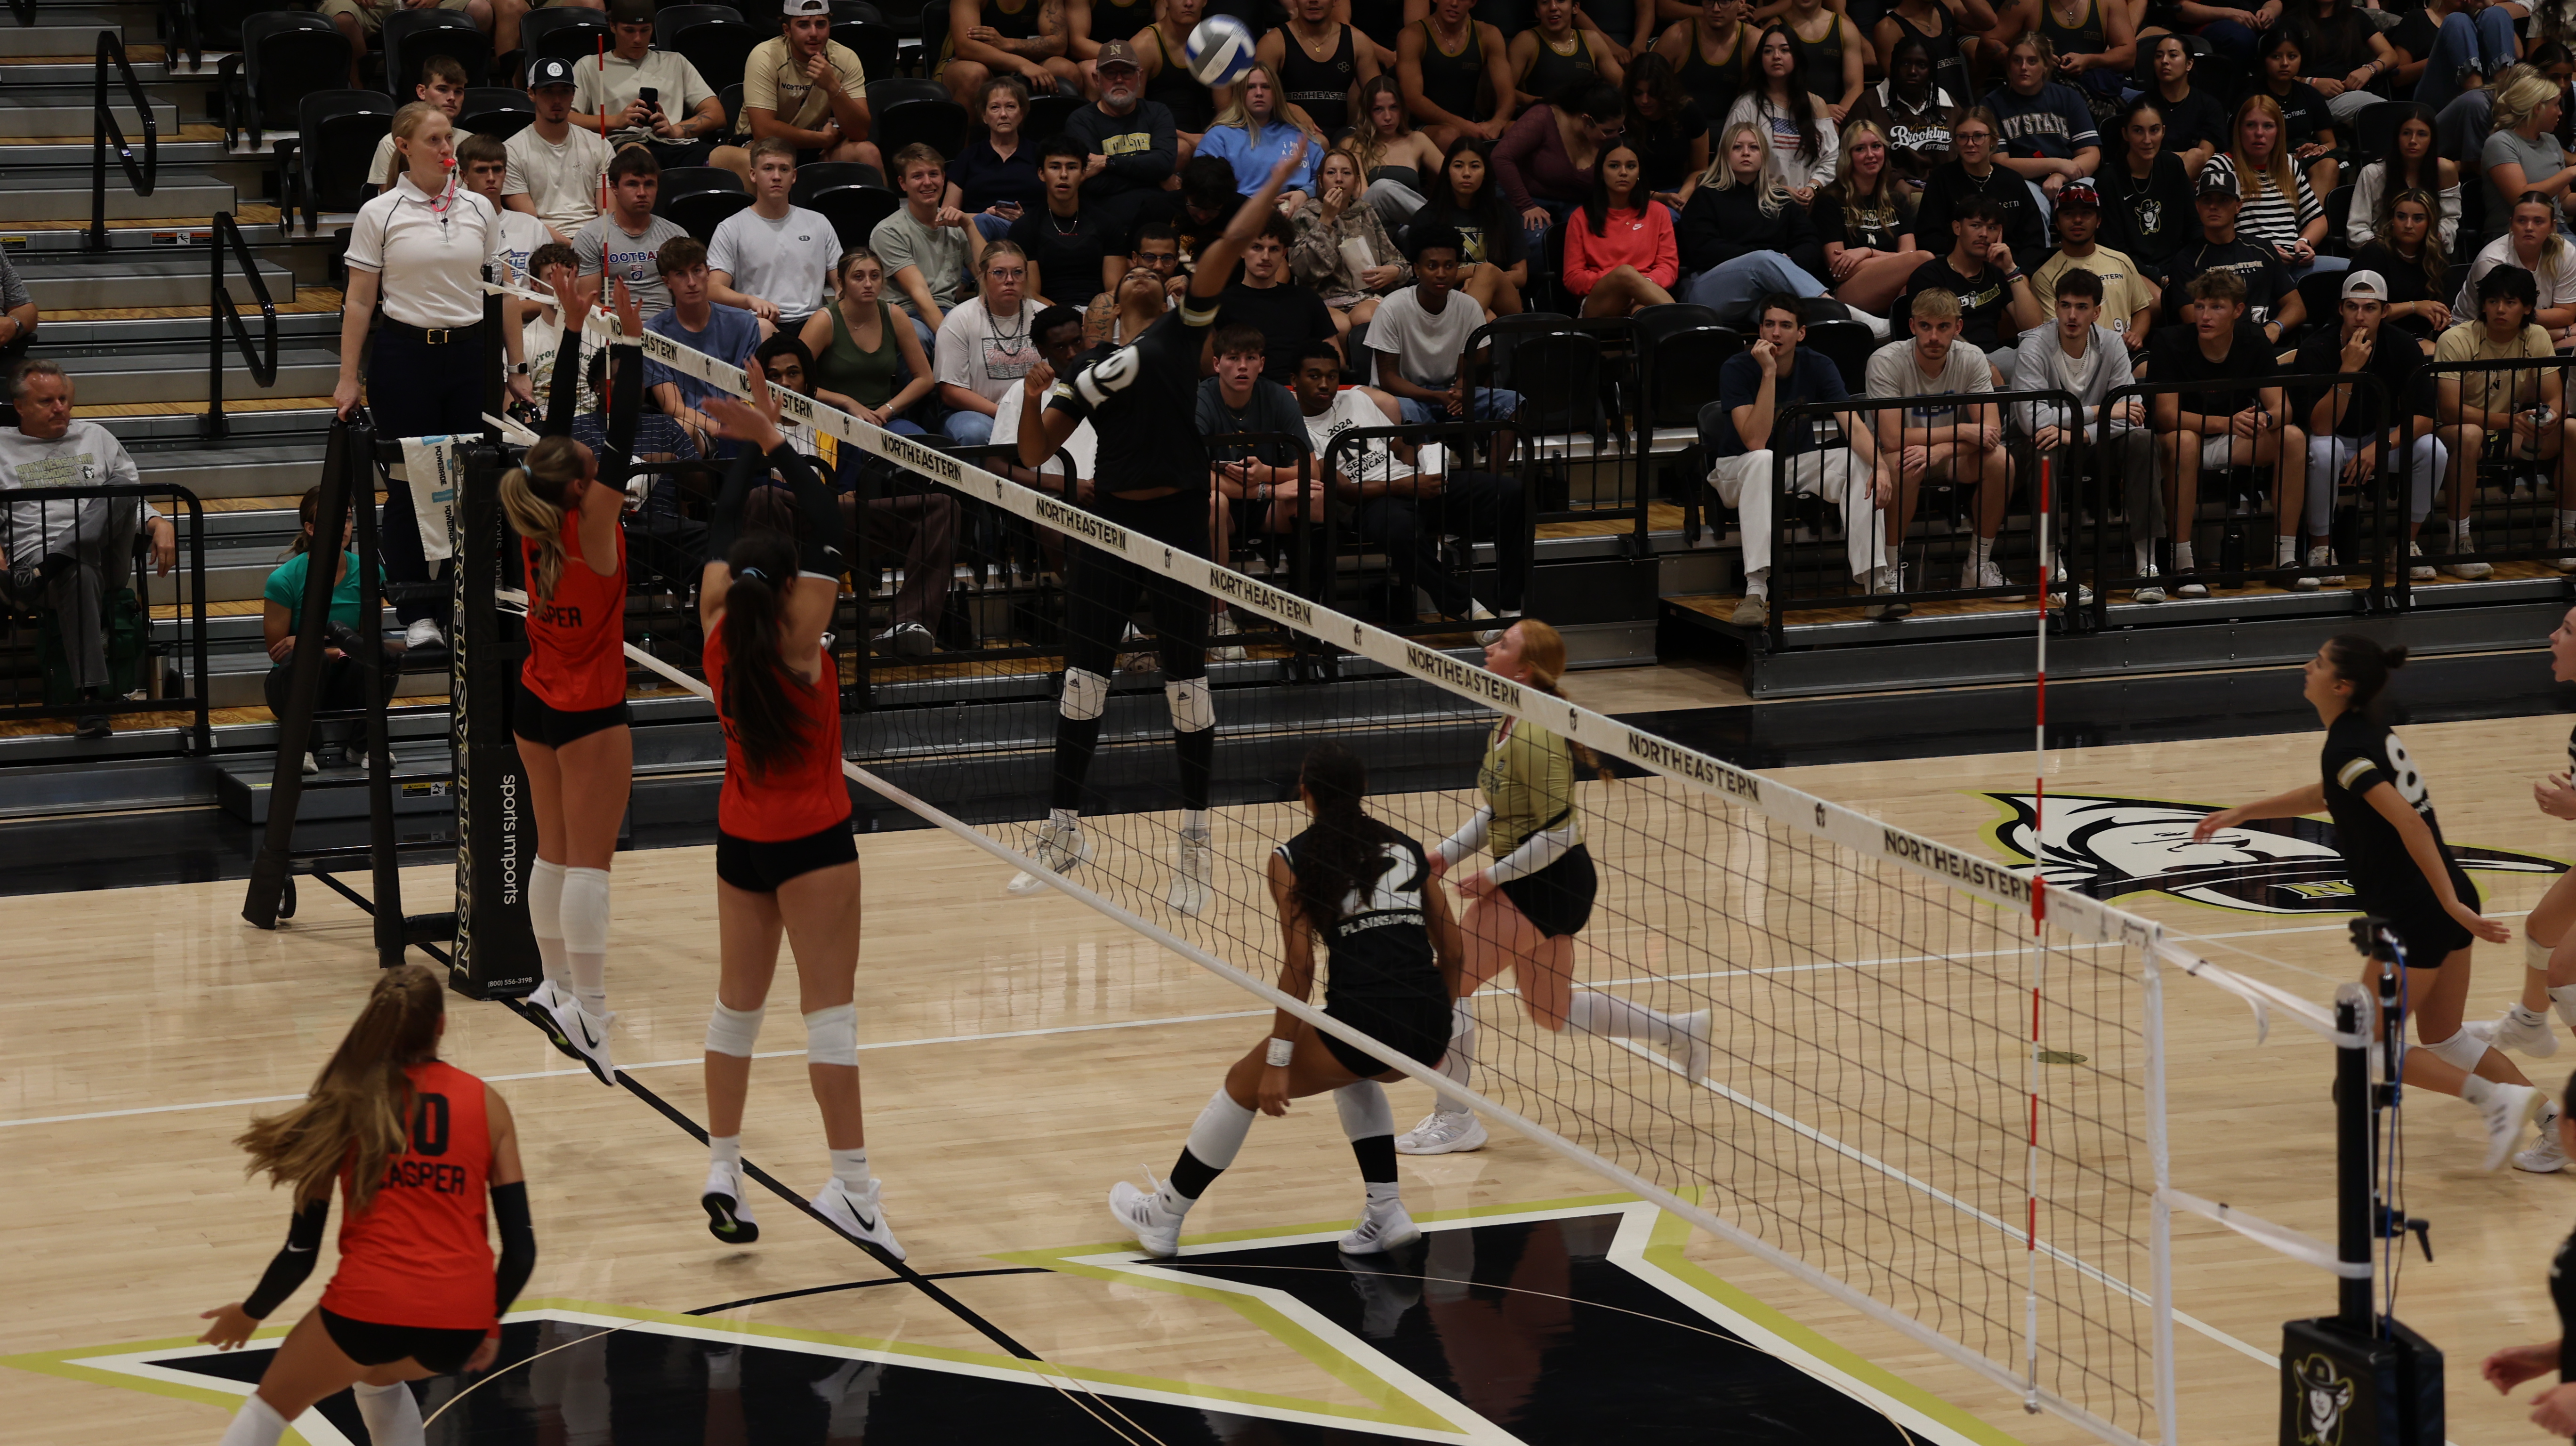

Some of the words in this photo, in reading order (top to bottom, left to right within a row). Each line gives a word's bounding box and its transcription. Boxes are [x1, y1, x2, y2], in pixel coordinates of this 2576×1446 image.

[1110, 45, 1121, 56] N
[1890, 125, 1952, 151] Brooklyn
[2023, 112, 2067, 140] STATE
[2208, 173, 2226, 187] N
[1457, 233, 1488, 265] N
[1867, 233, 1877, 245] N
[2251, 305, 2270, 324] 71
[611, 318, 677, 362] NOEASTERN
[2489, 379, 2501, 390] N
[1328, 418, 1353, 436] 2024
[15, 453, 94, 475] NORTHEASTERN
[435, 446, 447, 487] POWERADE
[881, 433, 962, 483] NORTHEASTERN
[1036, 498, 1127, 551] NORTHEASTERN
[1210, 568, 1312, 626] NORTHEASTERN
[1407, 646, 1521, 708] NORTHEASTERN
[1628, 732, 1760, 803] NORTHEASTERN
[2384, 733, 2426, 804] 8
[500, 775, 518, 831] sports
[500, 835, 519, 905] imports
[1884, 830, 2032, 903] NORTHEASTERN
[487, 979, 503, 988] (800)
[504, 977, 533, 987] 556-3198
[379, 1161, 465, 1196] ASPER
